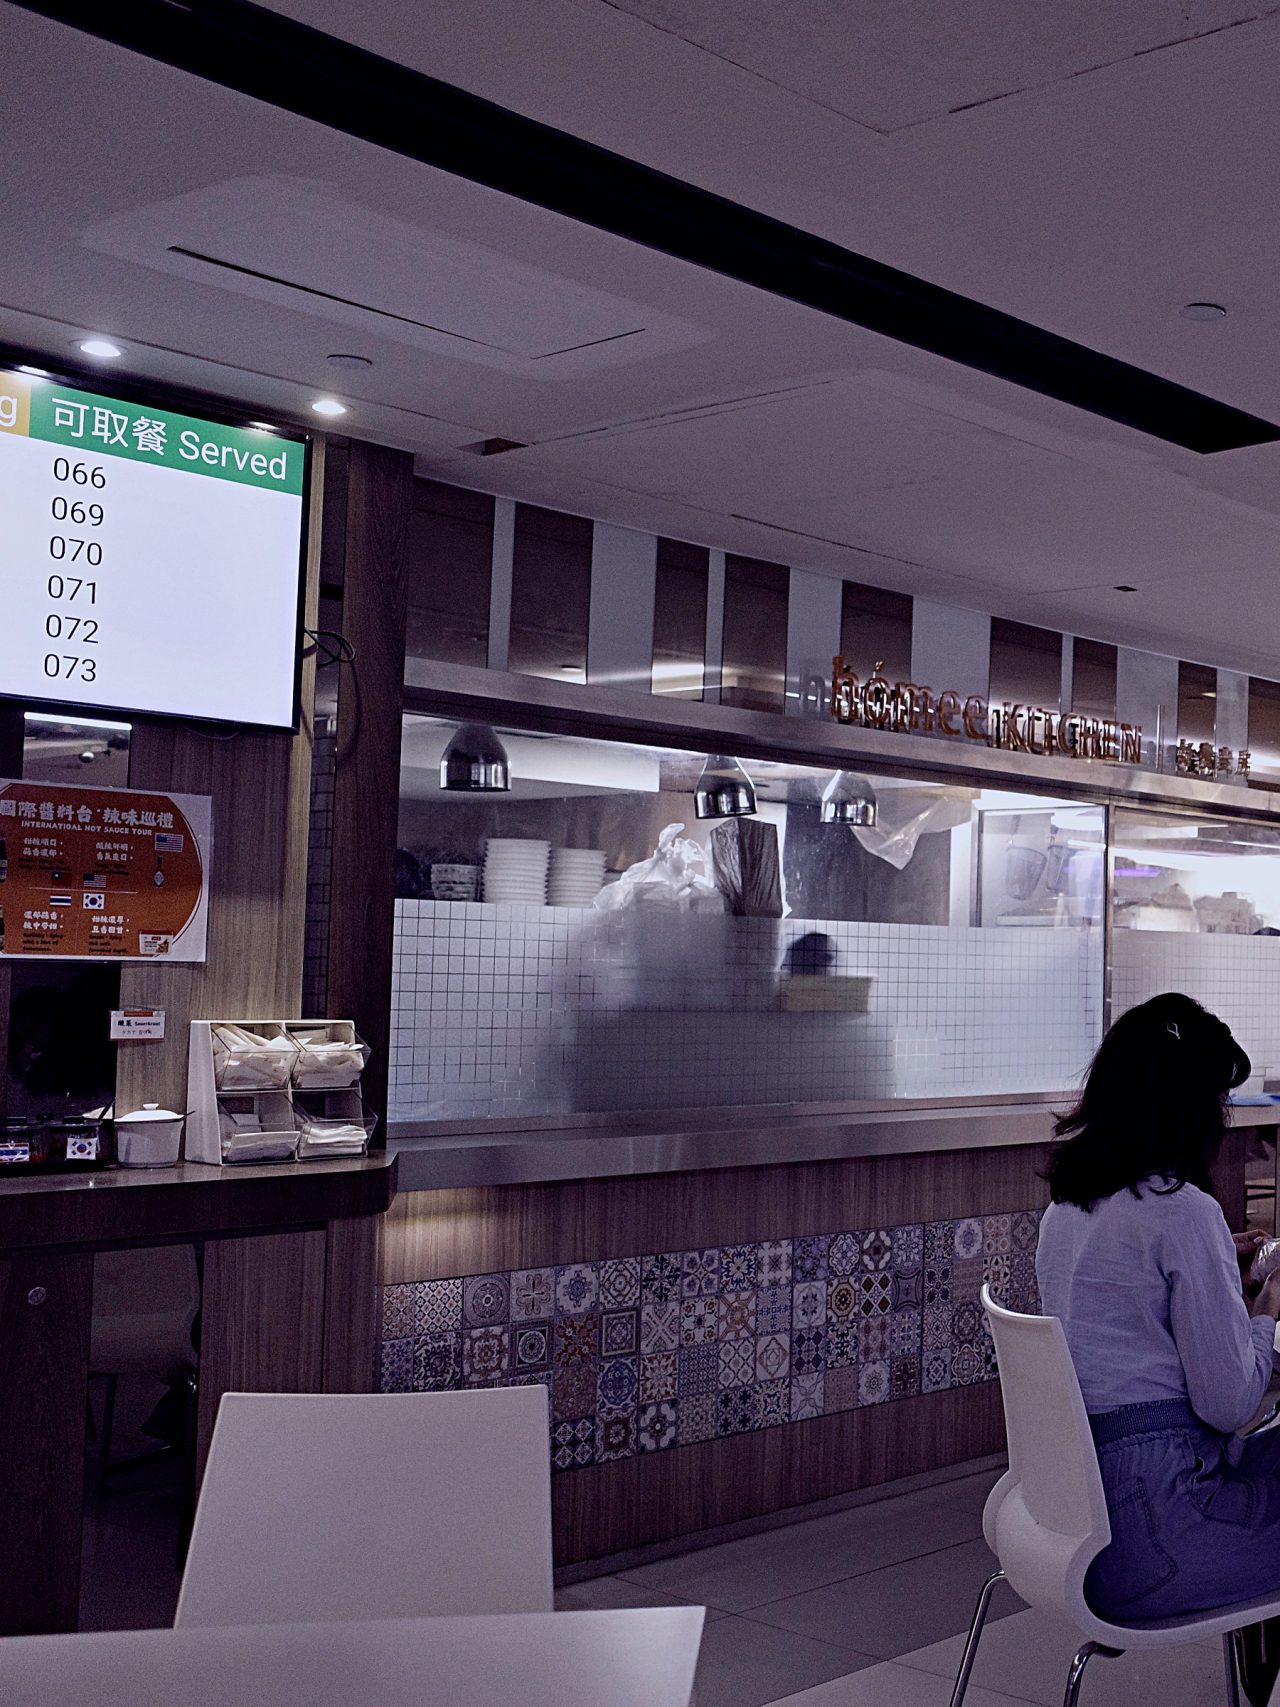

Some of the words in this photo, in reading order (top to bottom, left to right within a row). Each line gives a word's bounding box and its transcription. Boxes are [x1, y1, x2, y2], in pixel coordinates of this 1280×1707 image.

[52, 397, 169, 456] 可取餐
[179, 431, 287, 481] Served
[53, 457, 107, 489] 066
[51, 496, 105, 527] 069
[50, 535, 103, 566] 070
[47, 575, 98, 605] 071
[45, 614, 100, 644] 072
[43, 653, 97, 683] 073
[1001, 701, 1142, 764] KITCHEN
[84, 825, 102, 833] HOT
[103, 826, 130, 835] SAUCE
[131, 828, 153, 836] TOUR
